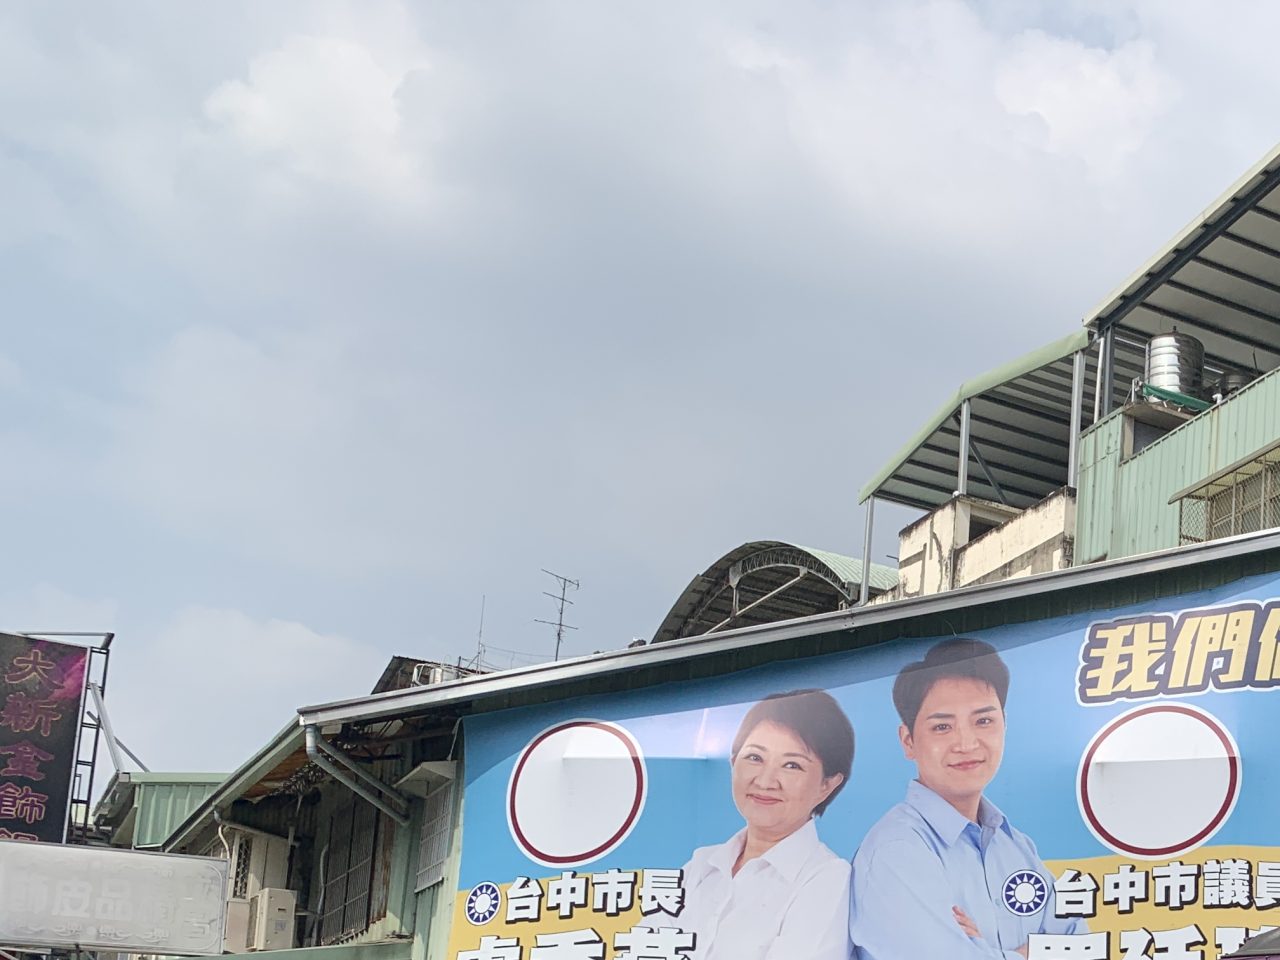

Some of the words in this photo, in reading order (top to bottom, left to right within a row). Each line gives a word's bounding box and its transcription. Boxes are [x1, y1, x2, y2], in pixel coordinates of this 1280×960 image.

[0, 648, 64, 842] 大新金飾
[505, 868, 686, 924] 台中市長
